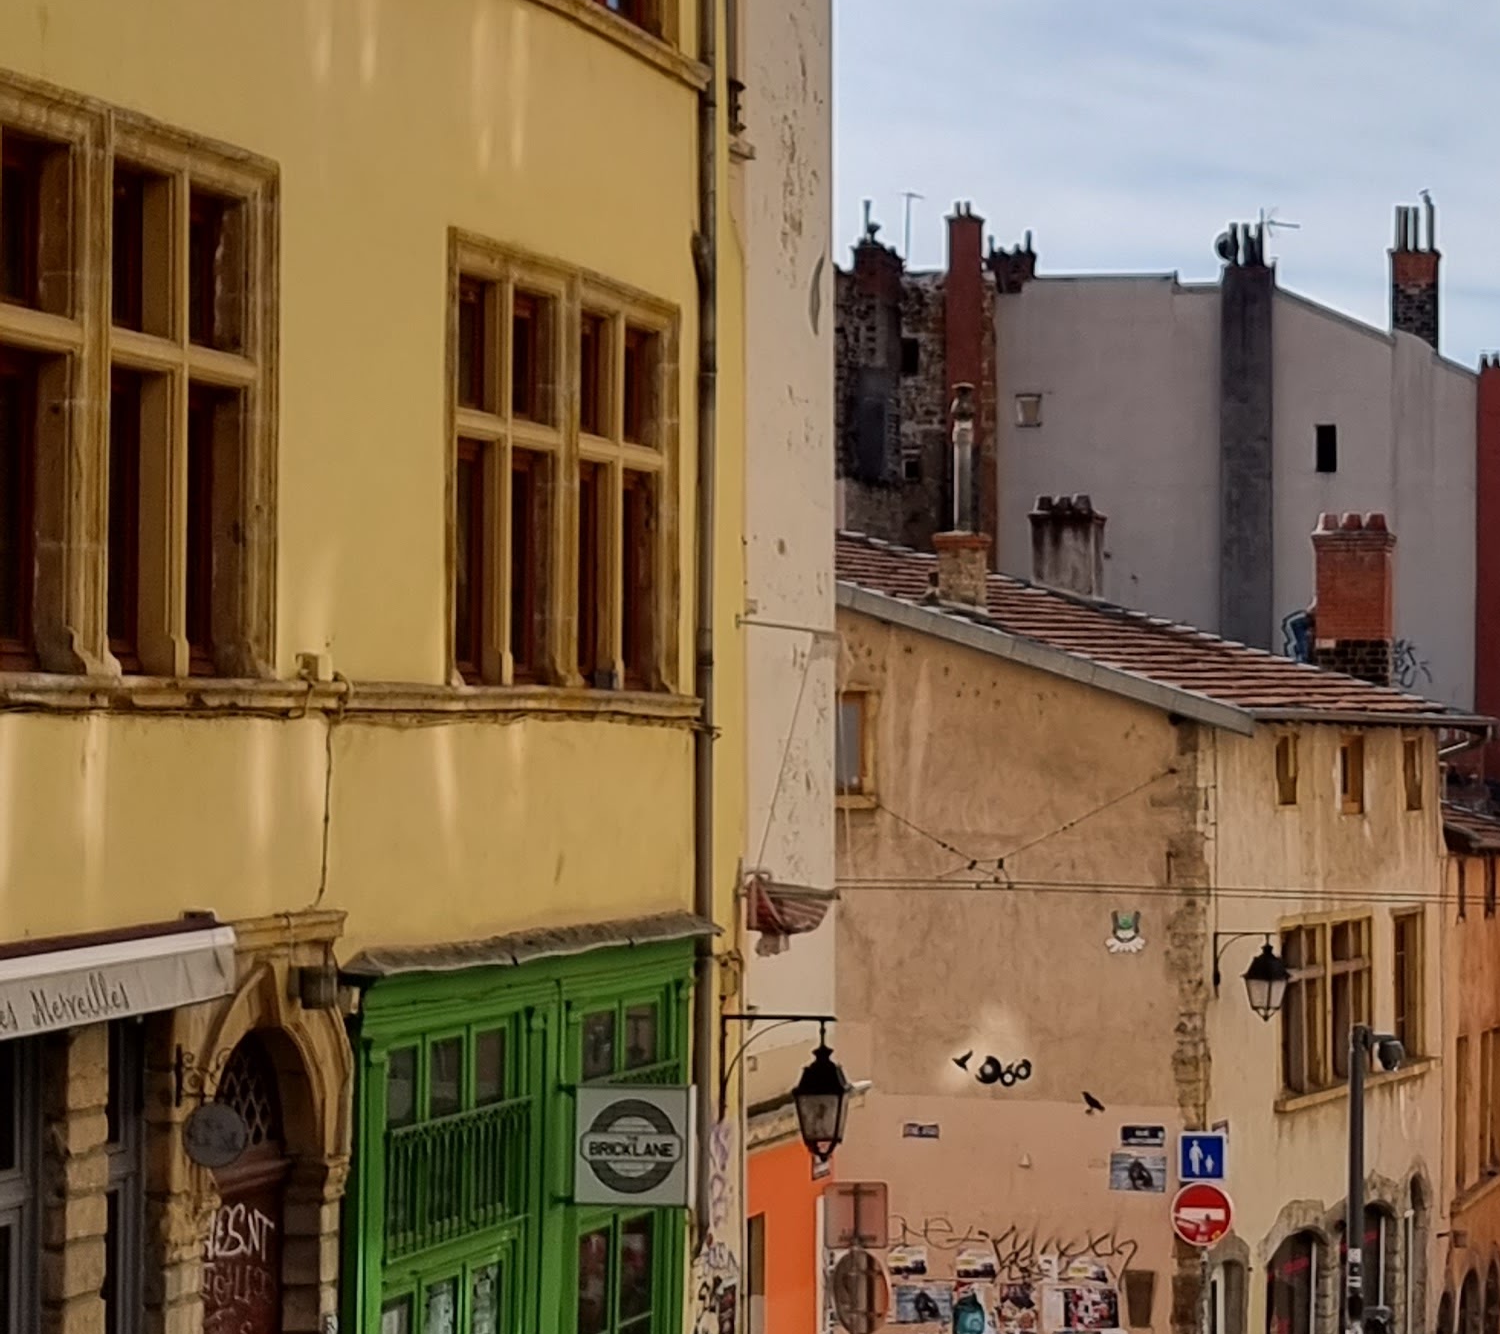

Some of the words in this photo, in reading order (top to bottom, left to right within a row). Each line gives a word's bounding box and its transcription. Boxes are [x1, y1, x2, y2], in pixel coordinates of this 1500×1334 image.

[30, 970, 130, 1028] Merveilles
[588, 1141, 632, 1156] BRICK
[633, 1142, 674, 1157] LANE
